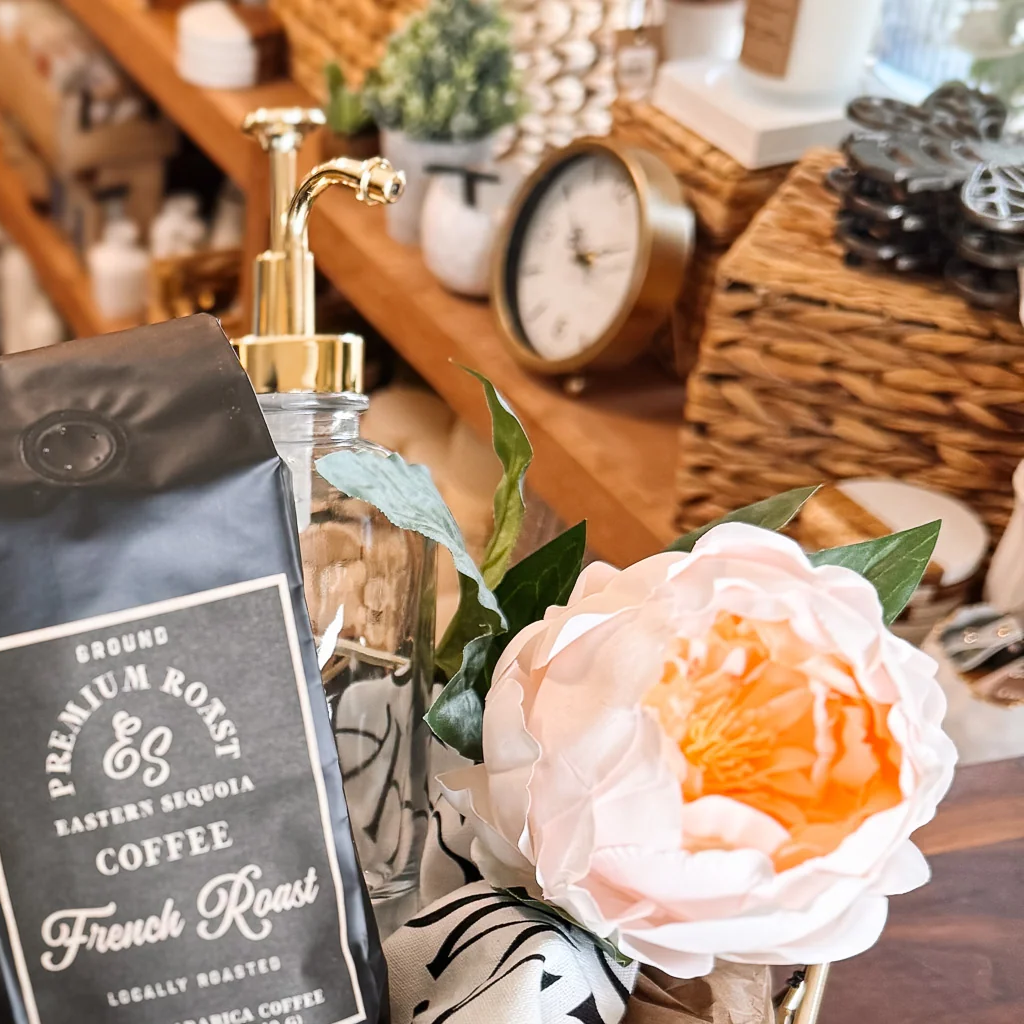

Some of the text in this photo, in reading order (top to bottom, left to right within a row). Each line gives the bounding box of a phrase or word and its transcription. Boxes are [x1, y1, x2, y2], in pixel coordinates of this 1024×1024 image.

[76, 626, 169, 664] GROUND
[45, 664, 241, 799] PREMIUM ROAST
[54, 775, 255, 836] EASTERN SEQUOIA
[95, 820, 234, 876] COFFEE
[41, 863, 320, 971] French Roast
[107, 956, 281, 1007] LOCALLY ROASTED
[258, 988, 325, 1019] COFFEE
